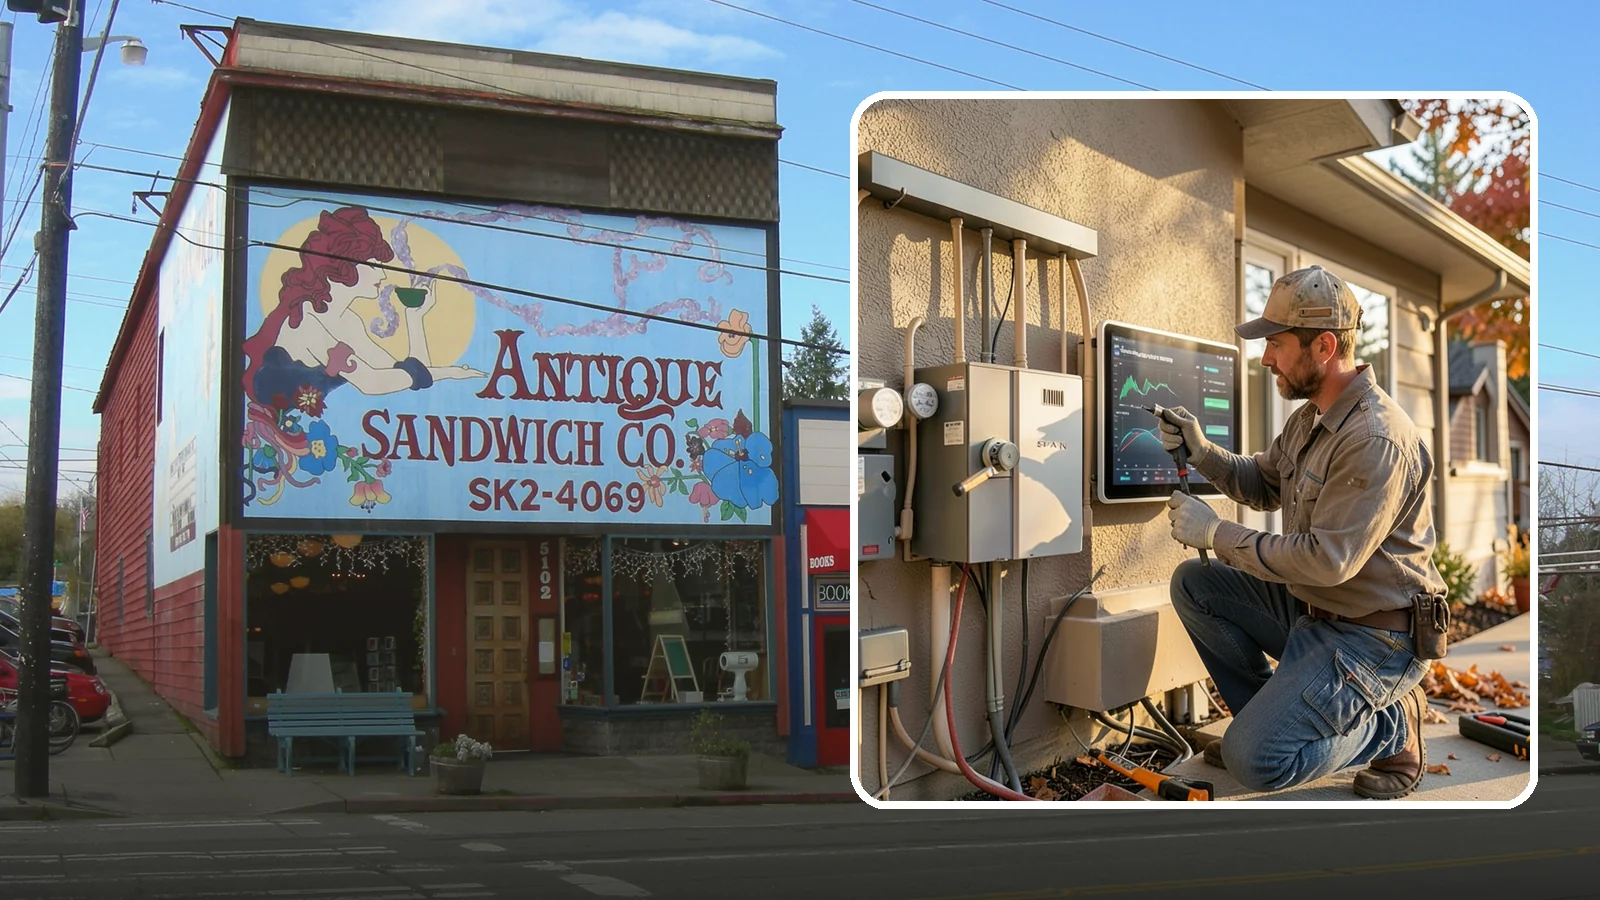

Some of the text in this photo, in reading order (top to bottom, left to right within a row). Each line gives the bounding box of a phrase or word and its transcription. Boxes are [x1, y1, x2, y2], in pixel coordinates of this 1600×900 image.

[475, 329, 724, 420] ANTIQUE
[361, 409, 685, 469] SANDWICH CO.
[468, 477, 646, 513] SK2-4069
[540, 541, 552, 600] 5102
[809, 555, 835, 569] BOOKS
